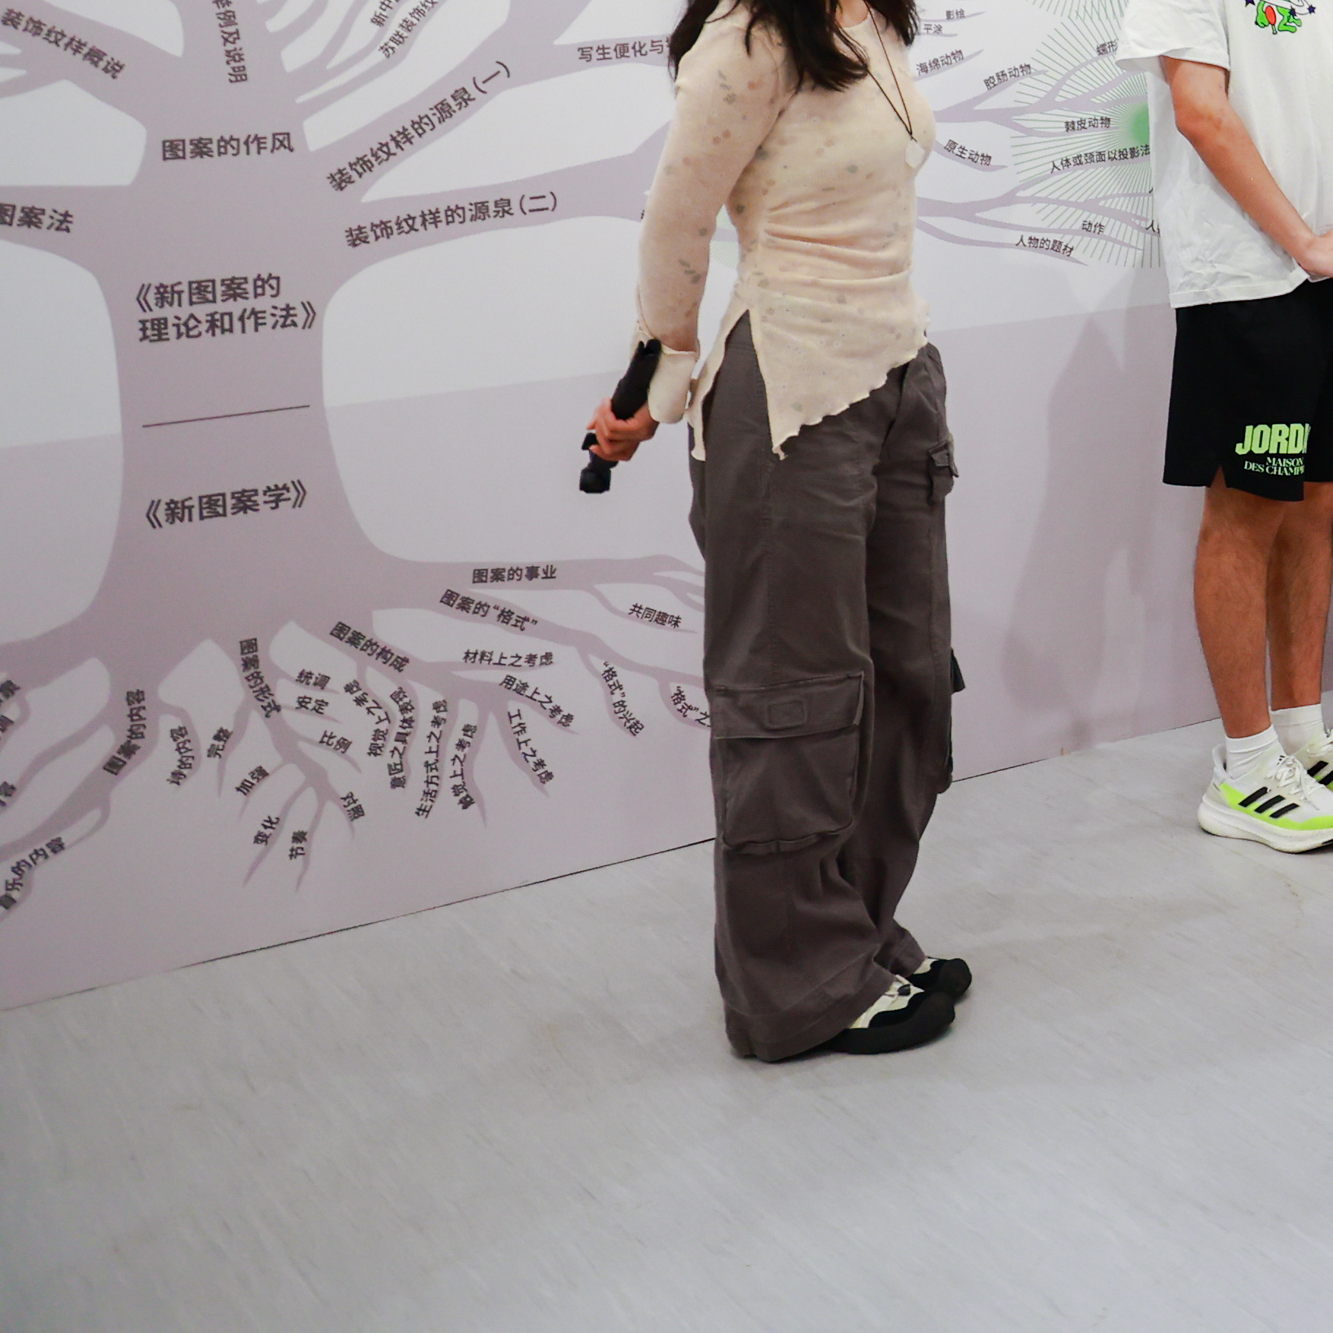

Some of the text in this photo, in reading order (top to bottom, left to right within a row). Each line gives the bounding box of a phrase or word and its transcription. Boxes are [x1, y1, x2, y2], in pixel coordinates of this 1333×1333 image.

[1, 7, 126, 80] 装饰纹样概说
[577, 39, 670, 62] 写生便化与
[915, 49, 965, 76] 海绵动物
[983, 63, 1032, 90] 腔肠动物
[326, 60, 513, 193] 装饰纹样的源泉（一）
[1064, 116, 1111, 133] 棘皮动物
[161, 131, 294, 162] 图案的作风
[943, 139, 992, 166] 原生动物
[345, 191, 559, 249] 装饰纹样的源泉（二）
[1081, 219, 1105, 235] 动作
[1016, 234, 1074, 257] 人物的题材
[135, 273, 282, 313] 《新图案的
[139, 301, 316, 343] 理论和作法》
[1244, 461, 1264, 473] DES
[145, 479, 307, 529] 《新图案学》
[472, 564, 557, 584] 图案的事业
[628, 602, 683, 630] 共同趣味
[329, 621, 410, 672] 图案的构成
[462, 649, 555, 668] 材料上之考虑
[239, 637, 281, 719] 图案的形式
[296, 668, 331, 691] 统调
[296, 694, 330, 716] 安定
[500, 673, 575, 728] 用途上之考虑
[670, 685, 711, 727] “格式”之
[103, 688, 147, 776] 图案的内容
[343, 678, 391, 757] 视觉上之考虑
[167, 726, 195, 787] 诗的内容
[207, 727, 234, 759] 完整
[318, 730, 353, 755] 比例
[507, 708, 555, 786] 工作上之考虑
[415, 699, 448, 819] 生活方式上之考虑
[235, 766, 270, 797] 加强
[340, 791, 365, 822] 对照
[253, 815, 281, 847] 变化
[288, 830, 308, 861] 节奏
